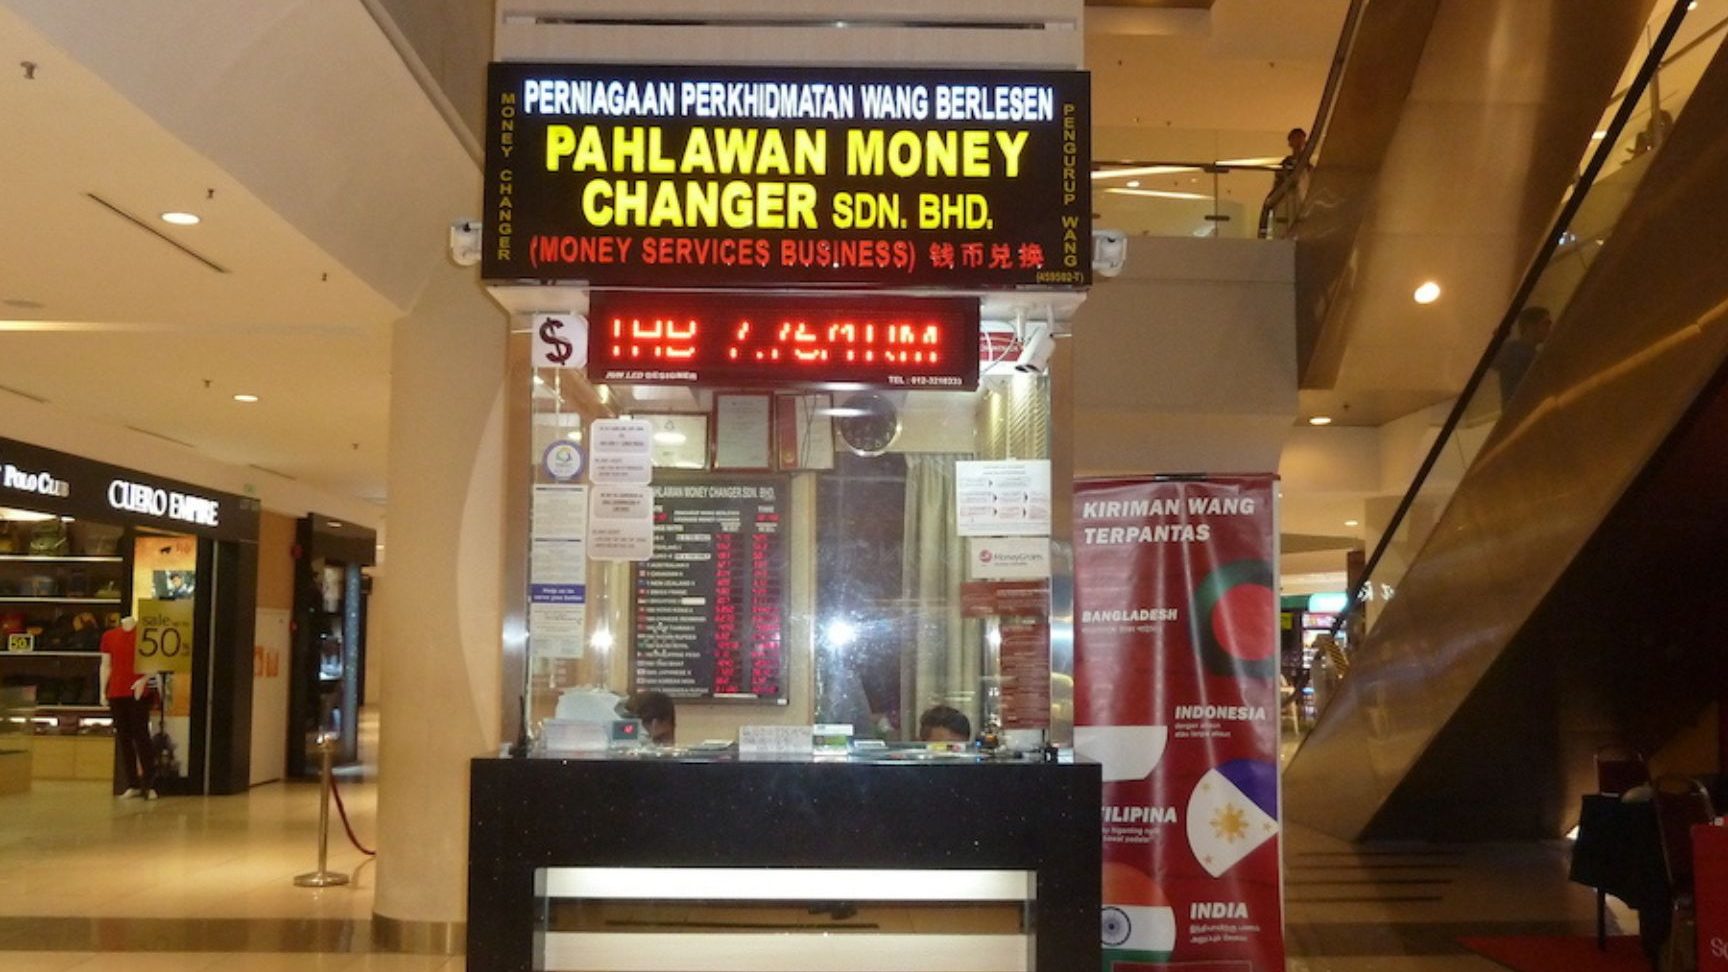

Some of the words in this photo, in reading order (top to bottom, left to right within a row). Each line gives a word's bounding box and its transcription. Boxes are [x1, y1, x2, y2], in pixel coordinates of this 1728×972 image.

[523, 79, 675, 117] PERNIAGAAN
[681, 82, 854, 119] PERKHIDMATAN
[861, 85, 928, 120] WANG
[936, 87, 1053, 120] BERLESEN
[500, 93, 516, 158] MONEY
[546, 125, 827, 175] PAHLAWAN
[846, 130, 1030, 178] MONEY
[1063, 104, 1077, 206] PENGURUP
[498, 169, 513, 261] CHANGER
[582, 179, 819, 230] CHANGER
[832, 192, 908, 230] SDN.
[919, 194, 994, 230] BHD.
[529, 236, 633, 269] (MONEY
[641, 237, 771, 267] SERVICES
[780, 240, 917, 272] BUSINESS)
[928, 242, 1046, 270] 钱币兑换
[1062, 216, 1080, 267] WANG
[108, 479, 168, 517] CUERO
[169, 491, 220, 527] EMPIRE
[1082, 499, 1180, 518] KIRIMAN
[1187, 497, 1256, 515] WANG
[1084, 524, 1211, 544] TERPANTAS
[1081, 608, 1178, 623] BANGLADESH
[1174, 705, 1266, 721] INDONESIA
[1101, 806, 1177, 823] ILIPINA
[1189, 902, 1249, 919] INDIA
